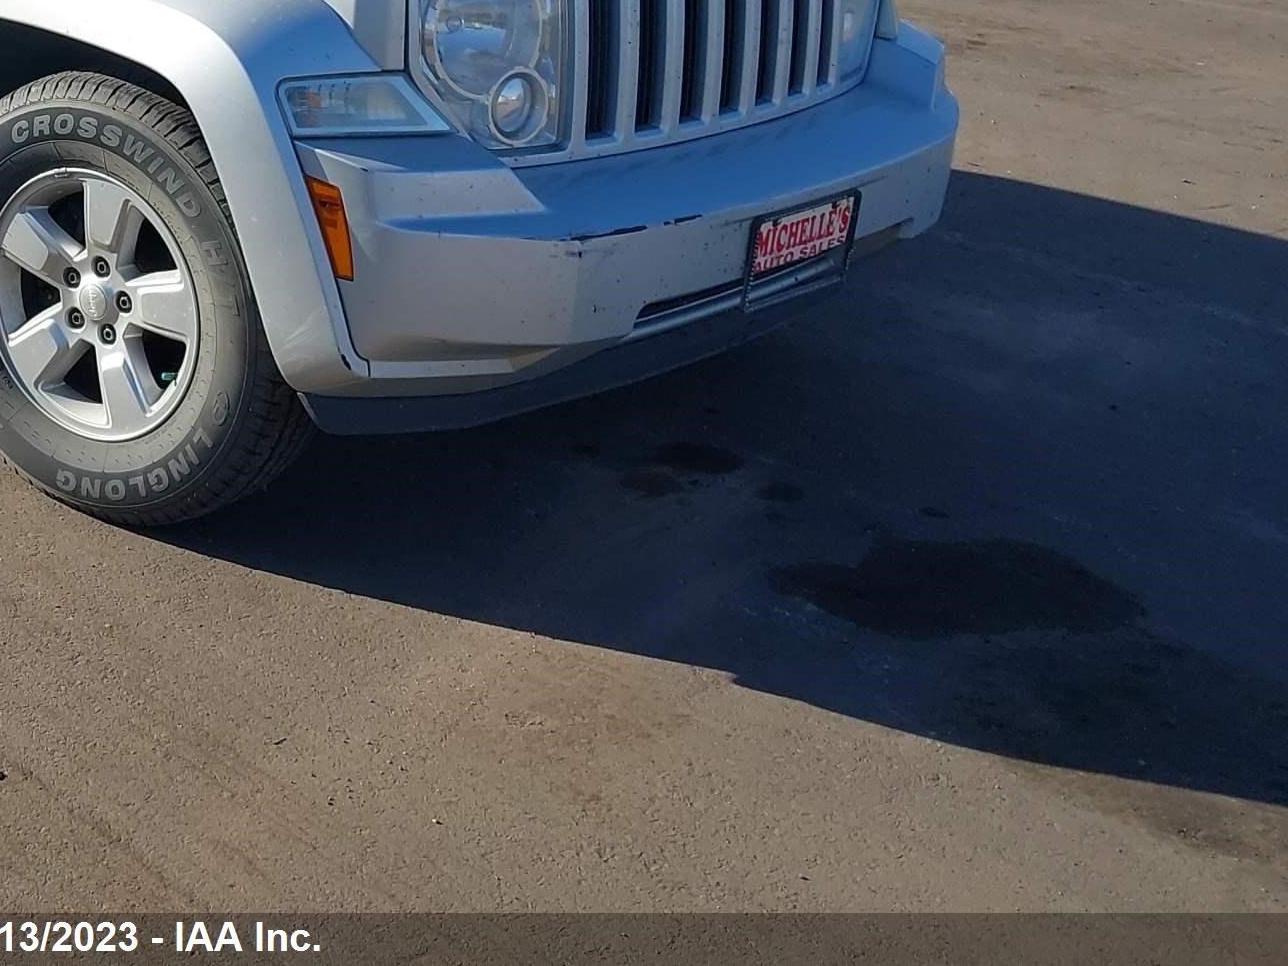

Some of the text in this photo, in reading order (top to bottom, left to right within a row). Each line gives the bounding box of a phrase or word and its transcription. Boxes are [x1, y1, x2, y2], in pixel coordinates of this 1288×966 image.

[11, 112, 241, 318] CROSSWIND H/T
[757, 206, 850, 258] MICHELLE'S
[754, 235, 846, 272] AUTO SALES
[55, 431, 215, 502] LINGLONG
